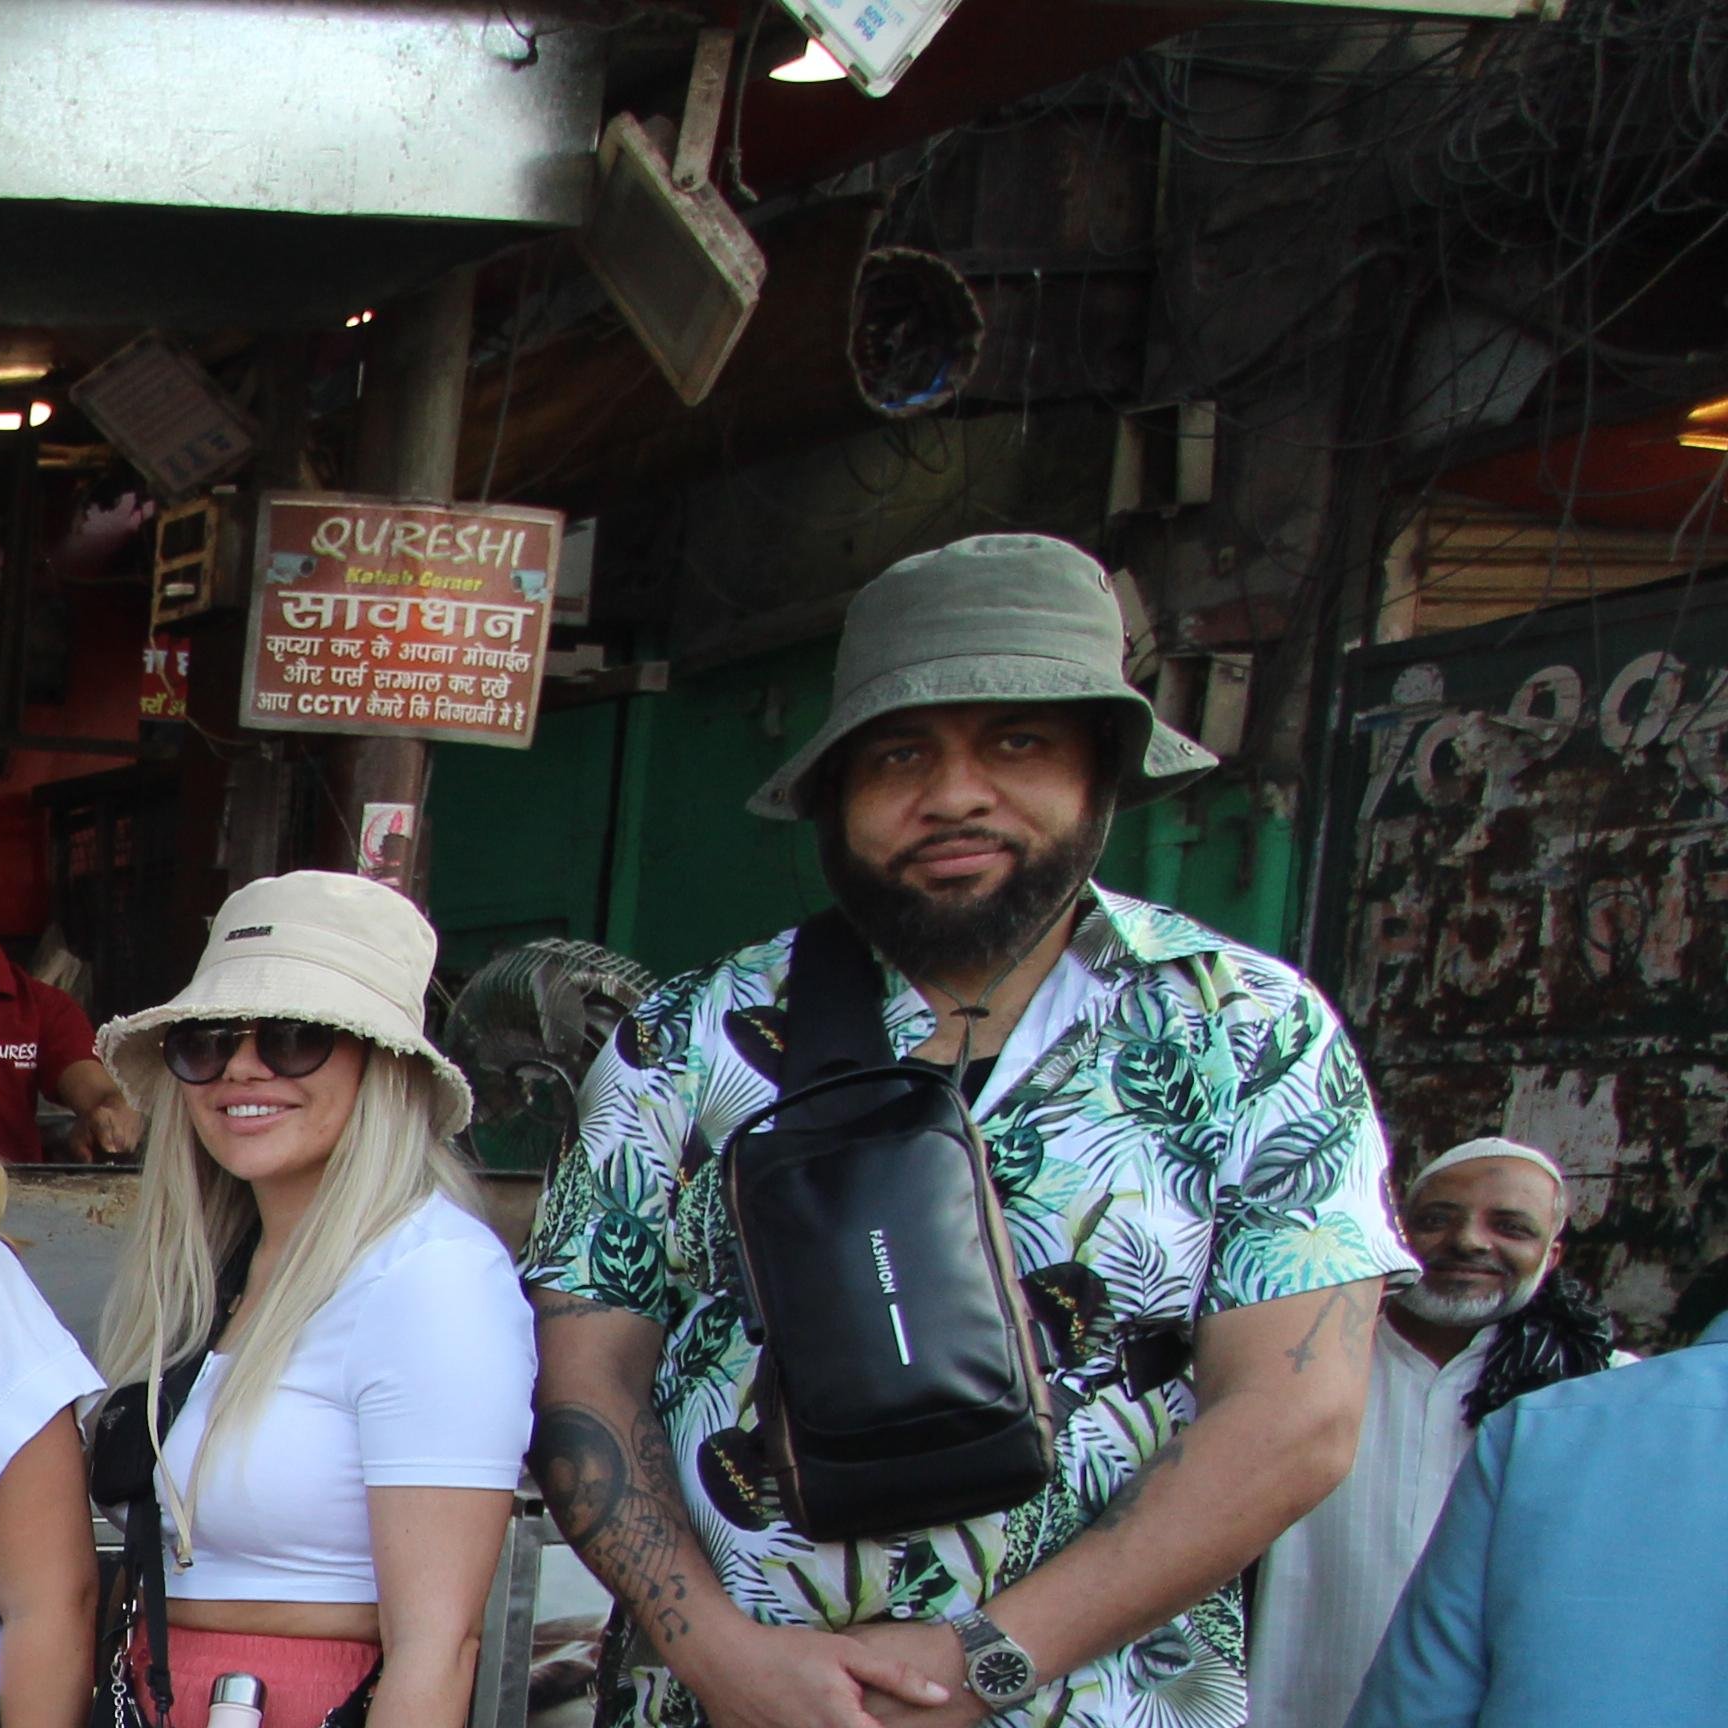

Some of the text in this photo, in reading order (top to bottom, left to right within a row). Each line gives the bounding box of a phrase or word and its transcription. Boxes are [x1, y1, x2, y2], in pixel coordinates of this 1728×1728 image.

[311, 516, 526, 569] QURESHI
[345, 566, 484, 592] Kabab Corner
[277, 590, 535, 643] सावधान
[330, 637, 365, 658] कर
[370, 634, 392, 660] के
[398, 642, 458, 665] अपना
[462, 641, 532, 674] मोबाईल
[282, 656, 325, 686] और
[447, 674, 476, 695] कर
[256, 691, 293, 713] आप
[297, 696, 362, 717] CCTV
[869, 1228, 896, 1295] FASHION
